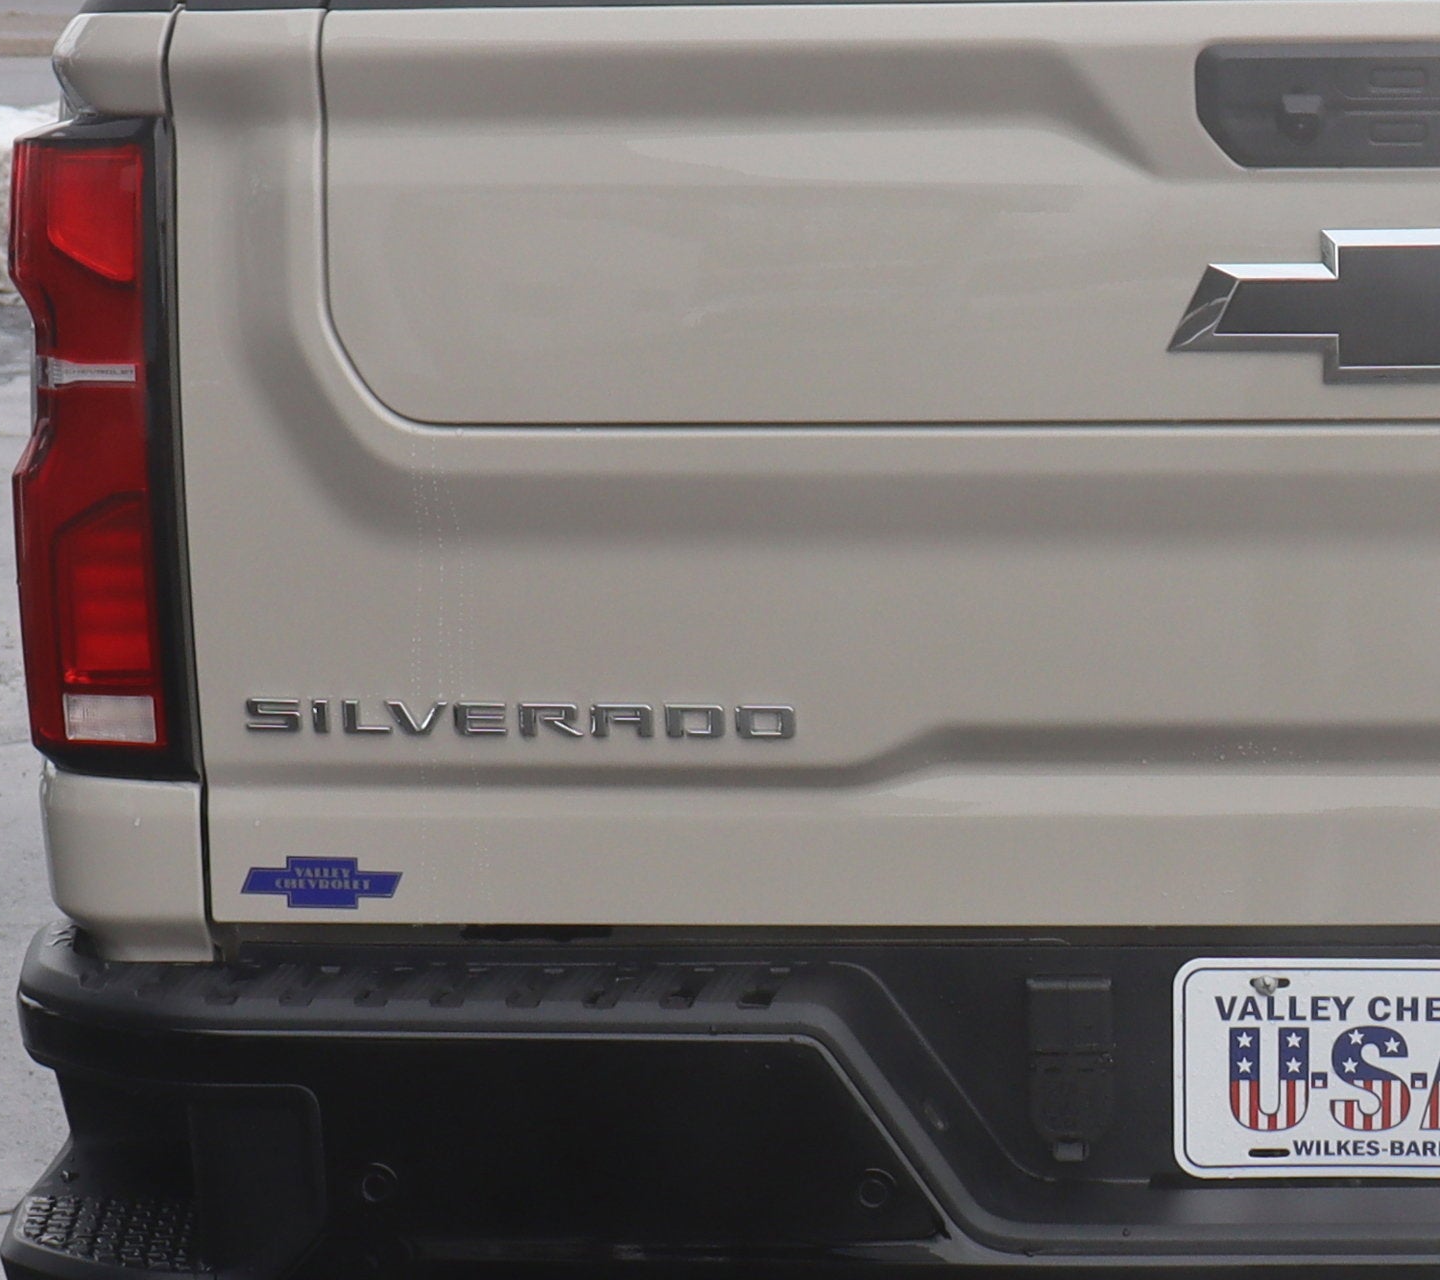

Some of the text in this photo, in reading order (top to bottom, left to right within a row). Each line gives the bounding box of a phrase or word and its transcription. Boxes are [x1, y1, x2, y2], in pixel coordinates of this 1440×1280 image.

[244, 697, 798, 739] SILVERADO
[294, 866, 352, 879] VALLEY
[274, 877, 371, 891] CHEVROLET
[1215, 995, 1355, 1022] VALLEY
